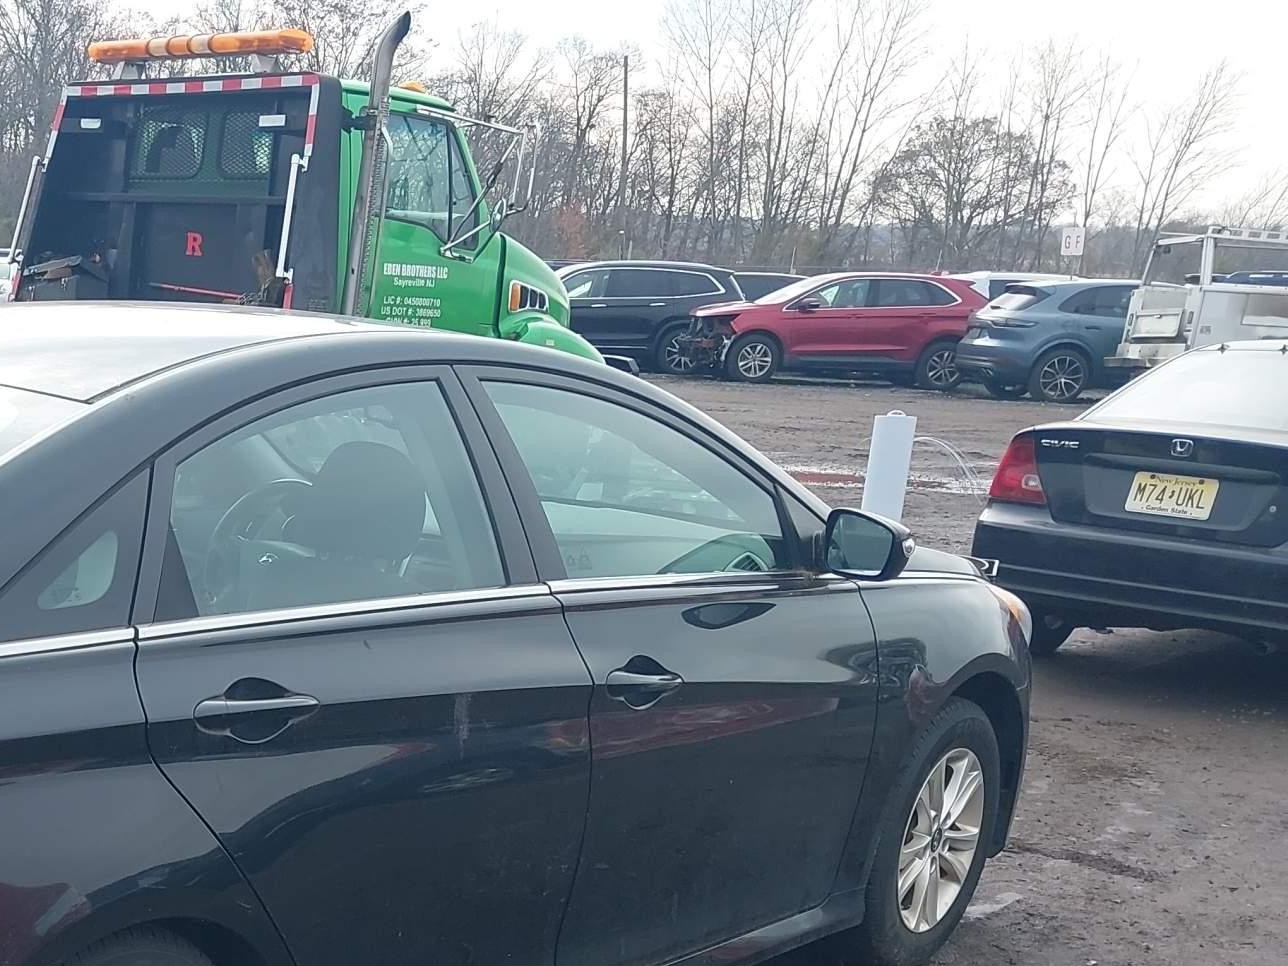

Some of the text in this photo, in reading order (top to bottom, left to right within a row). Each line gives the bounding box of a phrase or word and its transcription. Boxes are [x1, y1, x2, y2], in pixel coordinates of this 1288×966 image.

[185, 231, 202, 257] R
[383, 263, 449, 279] EDEN BROTHERS LLC
[393, 277, 435, 288] Sayreville NJ
[383, 296, 395, 305] LIC
[381, 306, 391, 315] US
[392, 306, 407, 316] DOT
[1041, 439, 1080, 449] CIVIC
